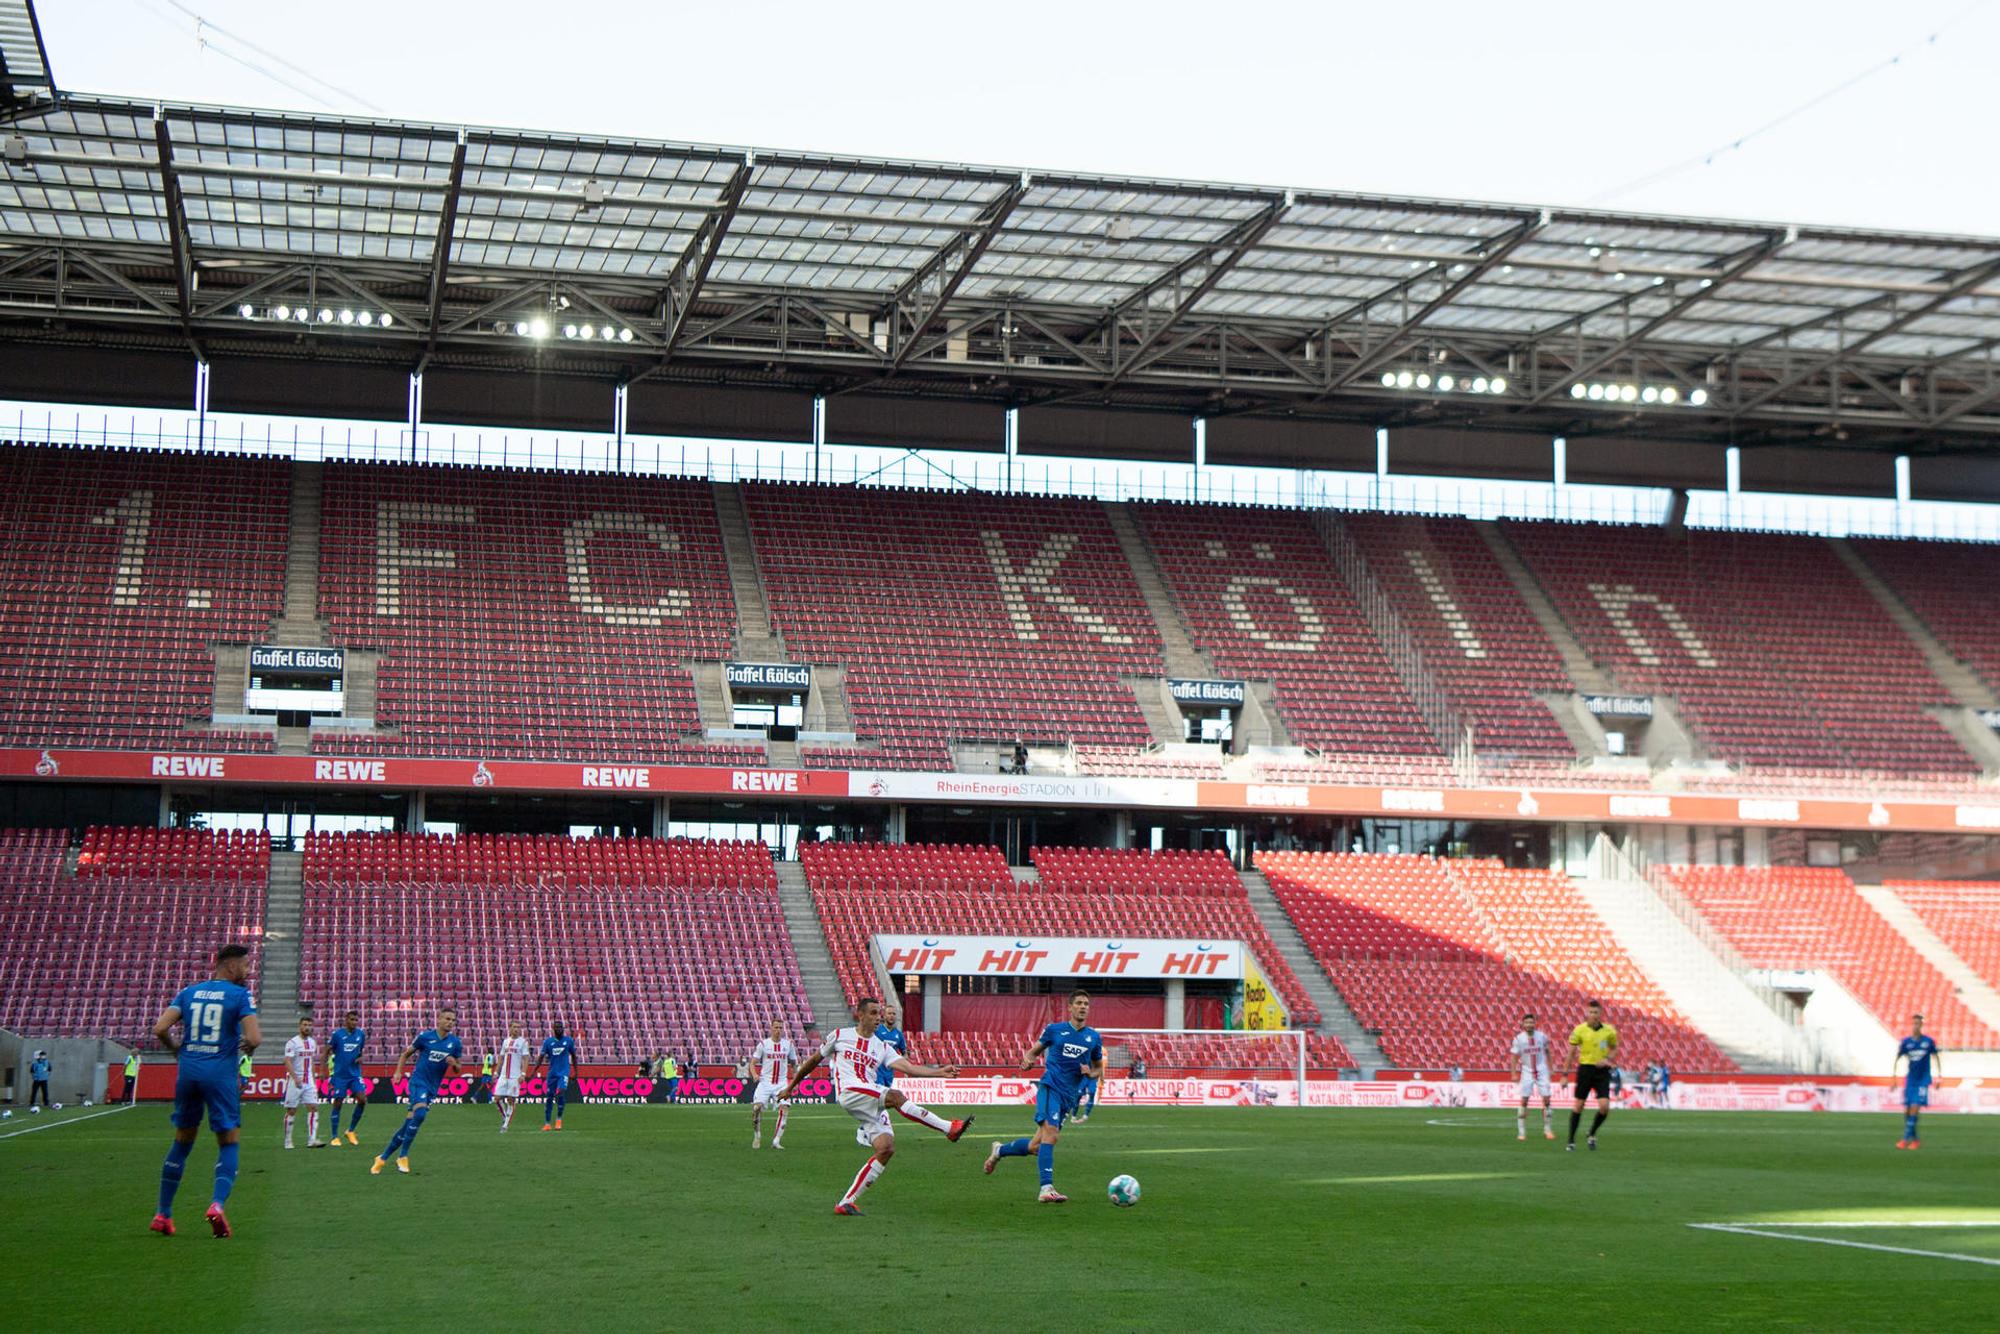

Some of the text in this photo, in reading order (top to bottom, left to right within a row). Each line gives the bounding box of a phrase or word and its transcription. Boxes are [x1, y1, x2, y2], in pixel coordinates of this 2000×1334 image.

[93, 489, 211, 608] 1.
[376, 501, 691, 625] FC
[252, 650, 342, 669] Gaffel Kölsch
[726, 666, 809, 685] Gaffel Kölsch
[1202, 683, 1243, 701] Kölsch
[152, 756, 225, 777] REWE
[315, 760, 386, 781] REWE
[582, 767, 650, 788] REWE
[732, 771, 798, 792] REWE
[937, 781, 1075, 797] RheinEnergieSTADION
[887, 949, 956, 971] HIT
[978, 950, 1048, 972] HIT
[1070, 951, 1139, 973] HIT
[1160, 953, 1229, 975] HIT
[189, 1002, 223, 1042] 19
[844, 1050, 878, 1069] REWE
[1064, 1045, 1082, 1056] SAP
[391, 1077, 469, 1096] wco
[577, 1078, 653, 1096] weco
[675, 1078, 744, 1096] weco
[897, 1080, 944, 1089] FANARTIKEL
[1001, 1085, 1018, 1095] NEU
[1213, 1086, 1231, 1097] NEU
[1407, 1088, 1425, 1098] NEU
[583, 1096, 648, 1104] feuerwerk
[675, 1096, 738, 1104] feuerwerk
[905, 1091, 993, 1104] ATALOG 2020/21
